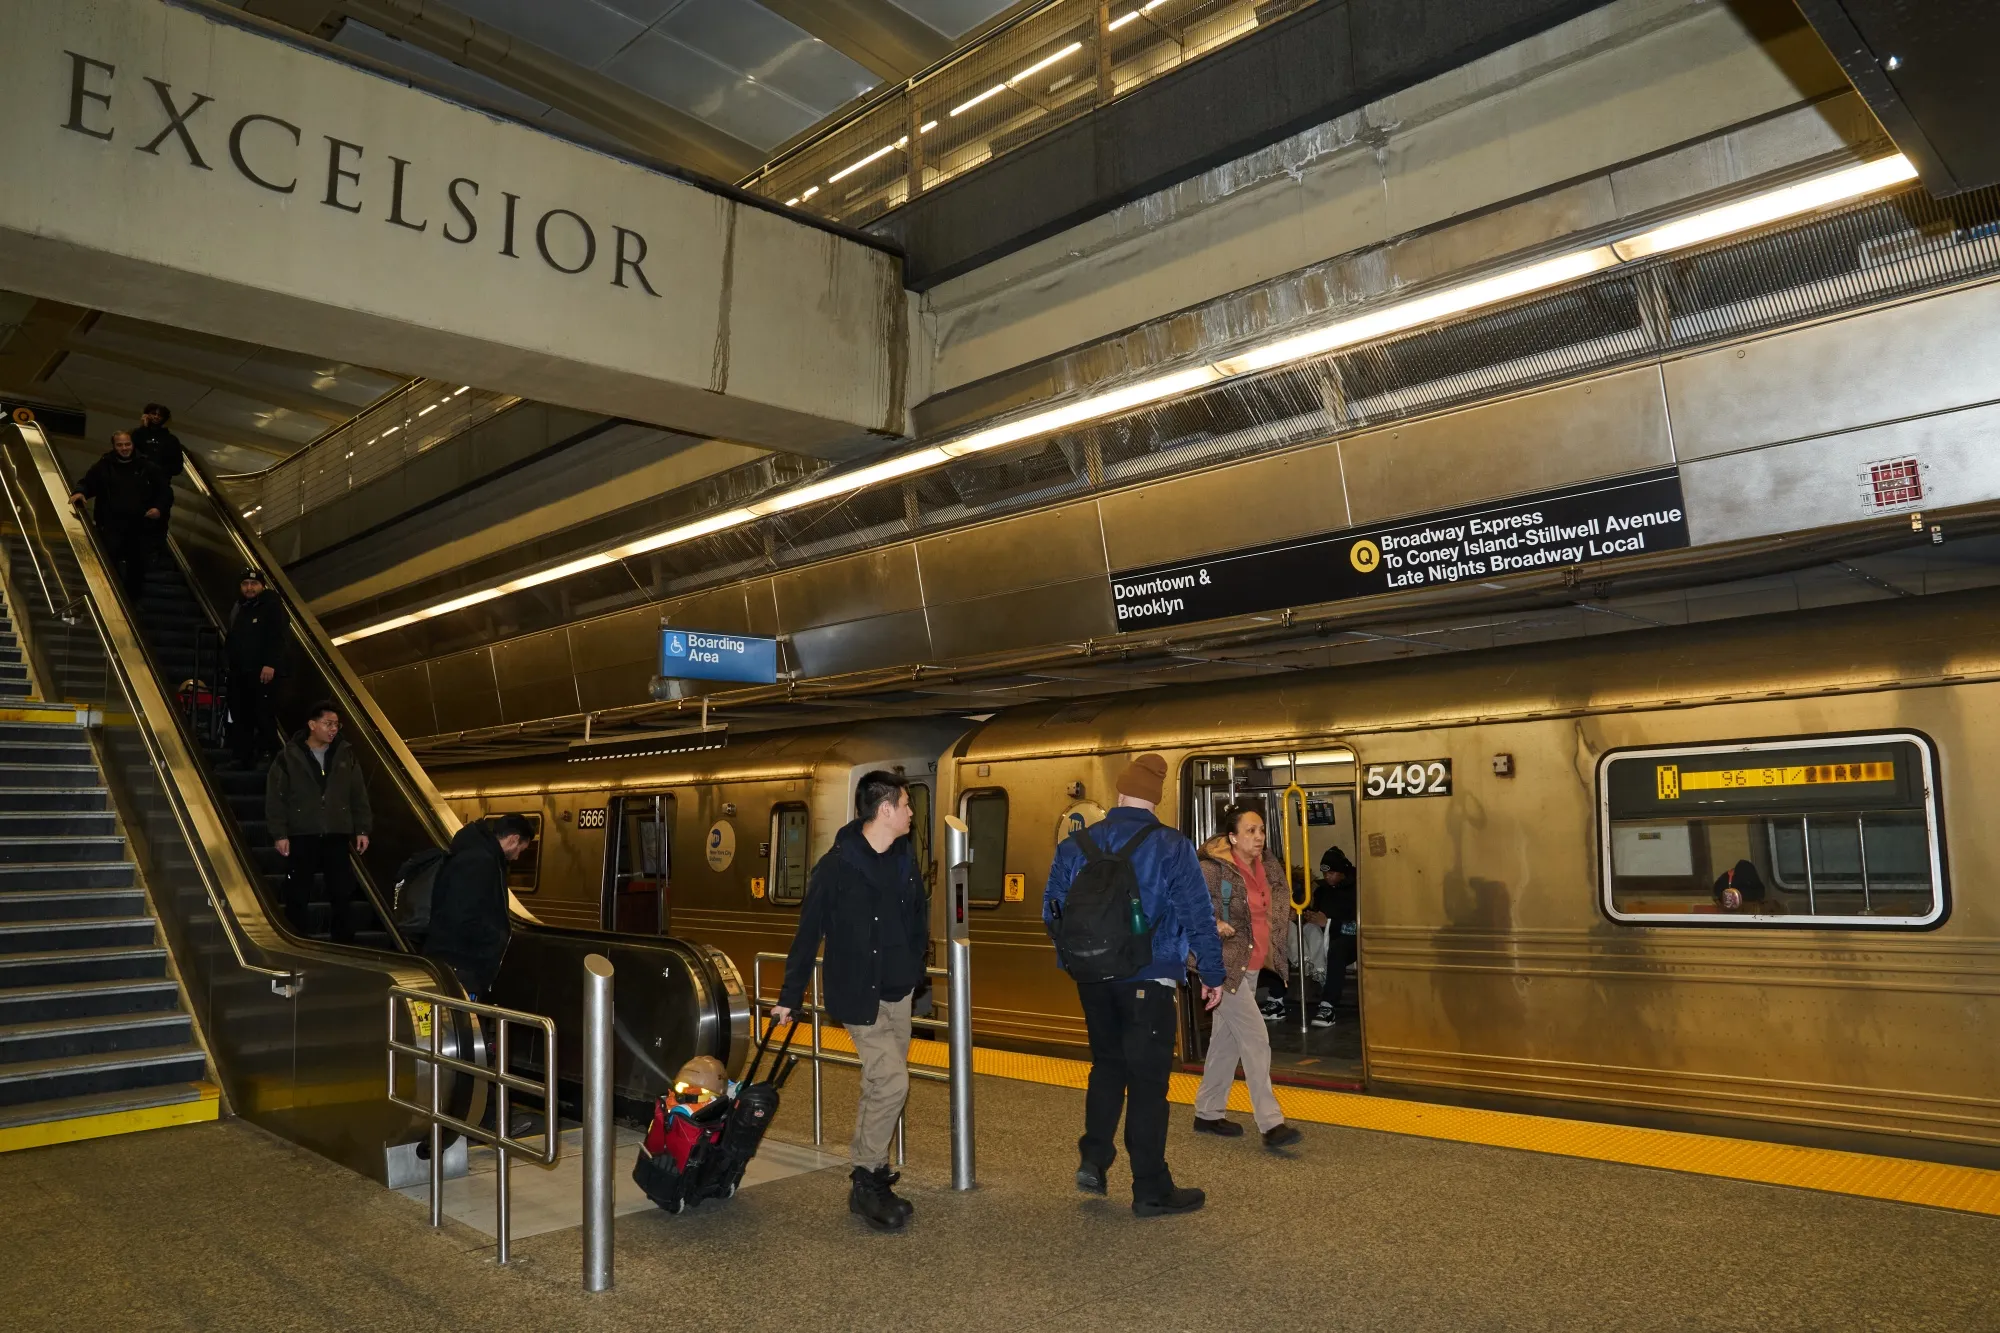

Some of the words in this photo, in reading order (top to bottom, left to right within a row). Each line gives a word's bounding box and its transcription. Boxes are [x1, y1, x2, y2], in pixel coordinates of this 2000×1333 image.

[60, 49, 663, 298] EXCELSIOR
[1380, 525, 1465, 551] Broadway
[1469, 511, 1544, 536] Express
[1383, 553, 1403, 569] To
[1406, 546, 1459, 566] Coney
[1463, 518, 1600, 556] Island-Stillwell
[1605, 508, 1682, 533] Avenue
[1356, 546, 1373, 566] Q
[1386, 571, 1424, 588] Late
[1428, 560, 1486, 582] Nights
[1490, 545, 1584, 572] Broadway
[1588, 531, 1645, 557] Local
[1113, 574, 1195, 600] Downtown
[1199, 568, 1212, 585] &
[1117, 597, 1184, 620] Brooklyn
[688, 634, 745, 654] Boarding
[688, 648, 719, 663] Area
[1367, 762, 1447, 796] 5492
[1660, 766, 1677, 798] Q
[1722, 770, 1747, 787] 96
[579, 809, 605, 827] 5666
